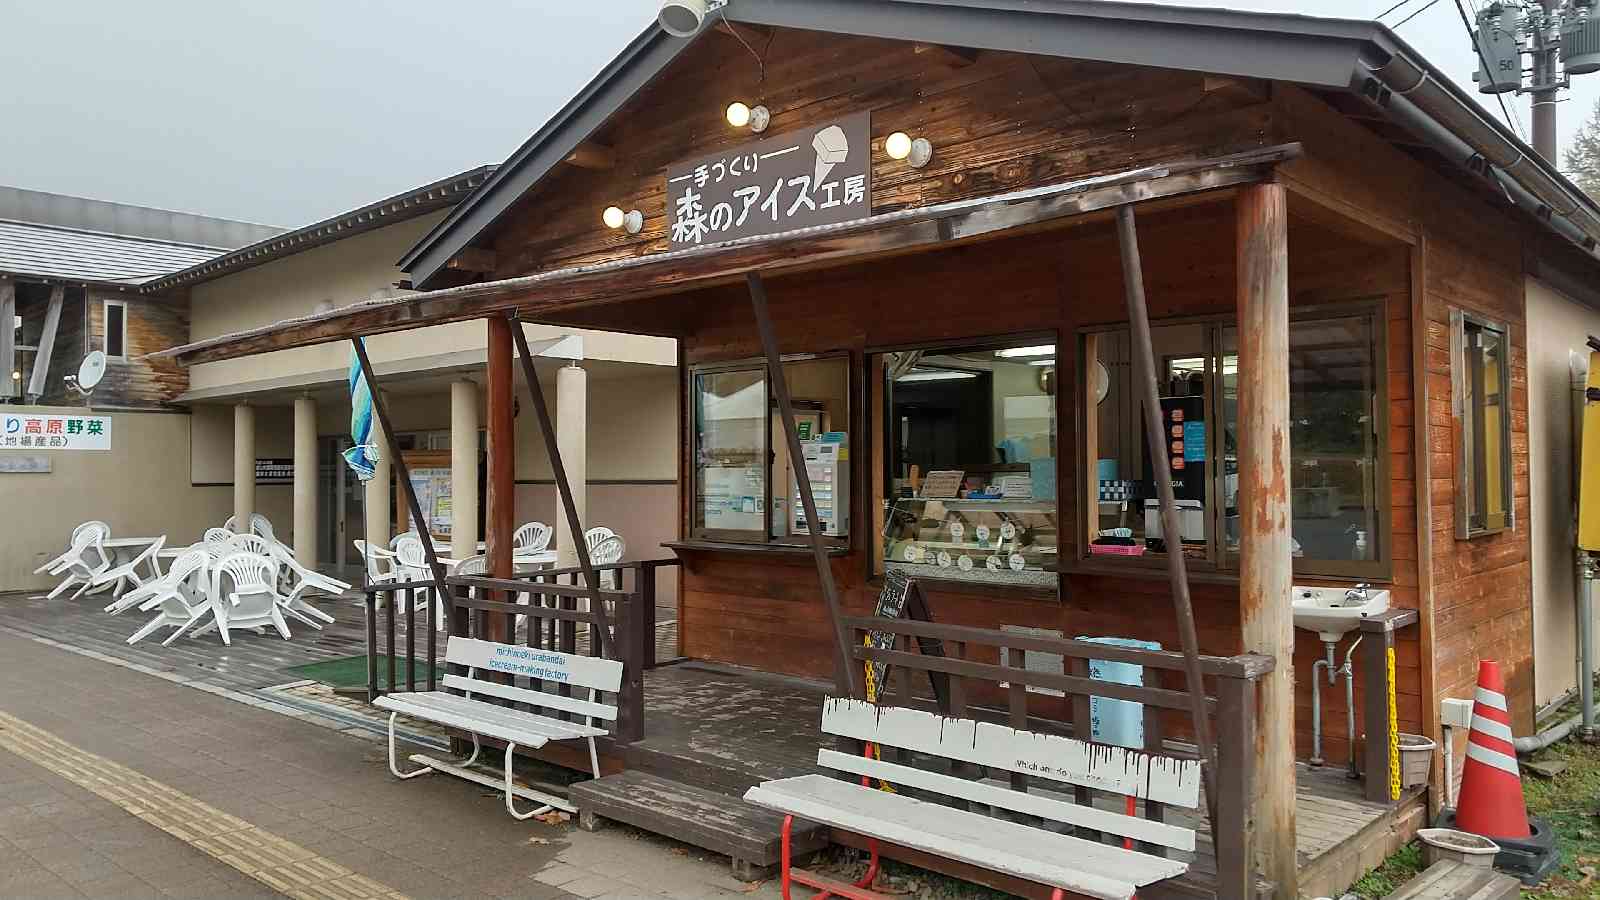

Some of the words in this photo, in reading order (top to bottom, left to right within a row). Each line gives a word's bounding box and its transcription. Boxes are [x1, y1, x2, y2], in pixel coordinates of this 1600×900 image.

[1499, 60, 1514, 72] 50
[693, 152, 759, 188] 手づくり
[671, 174, 866, 244] 森のアイス工房
[6, 417, 104, 436] り高原野菜
[544, 667, 569, 682] factory
